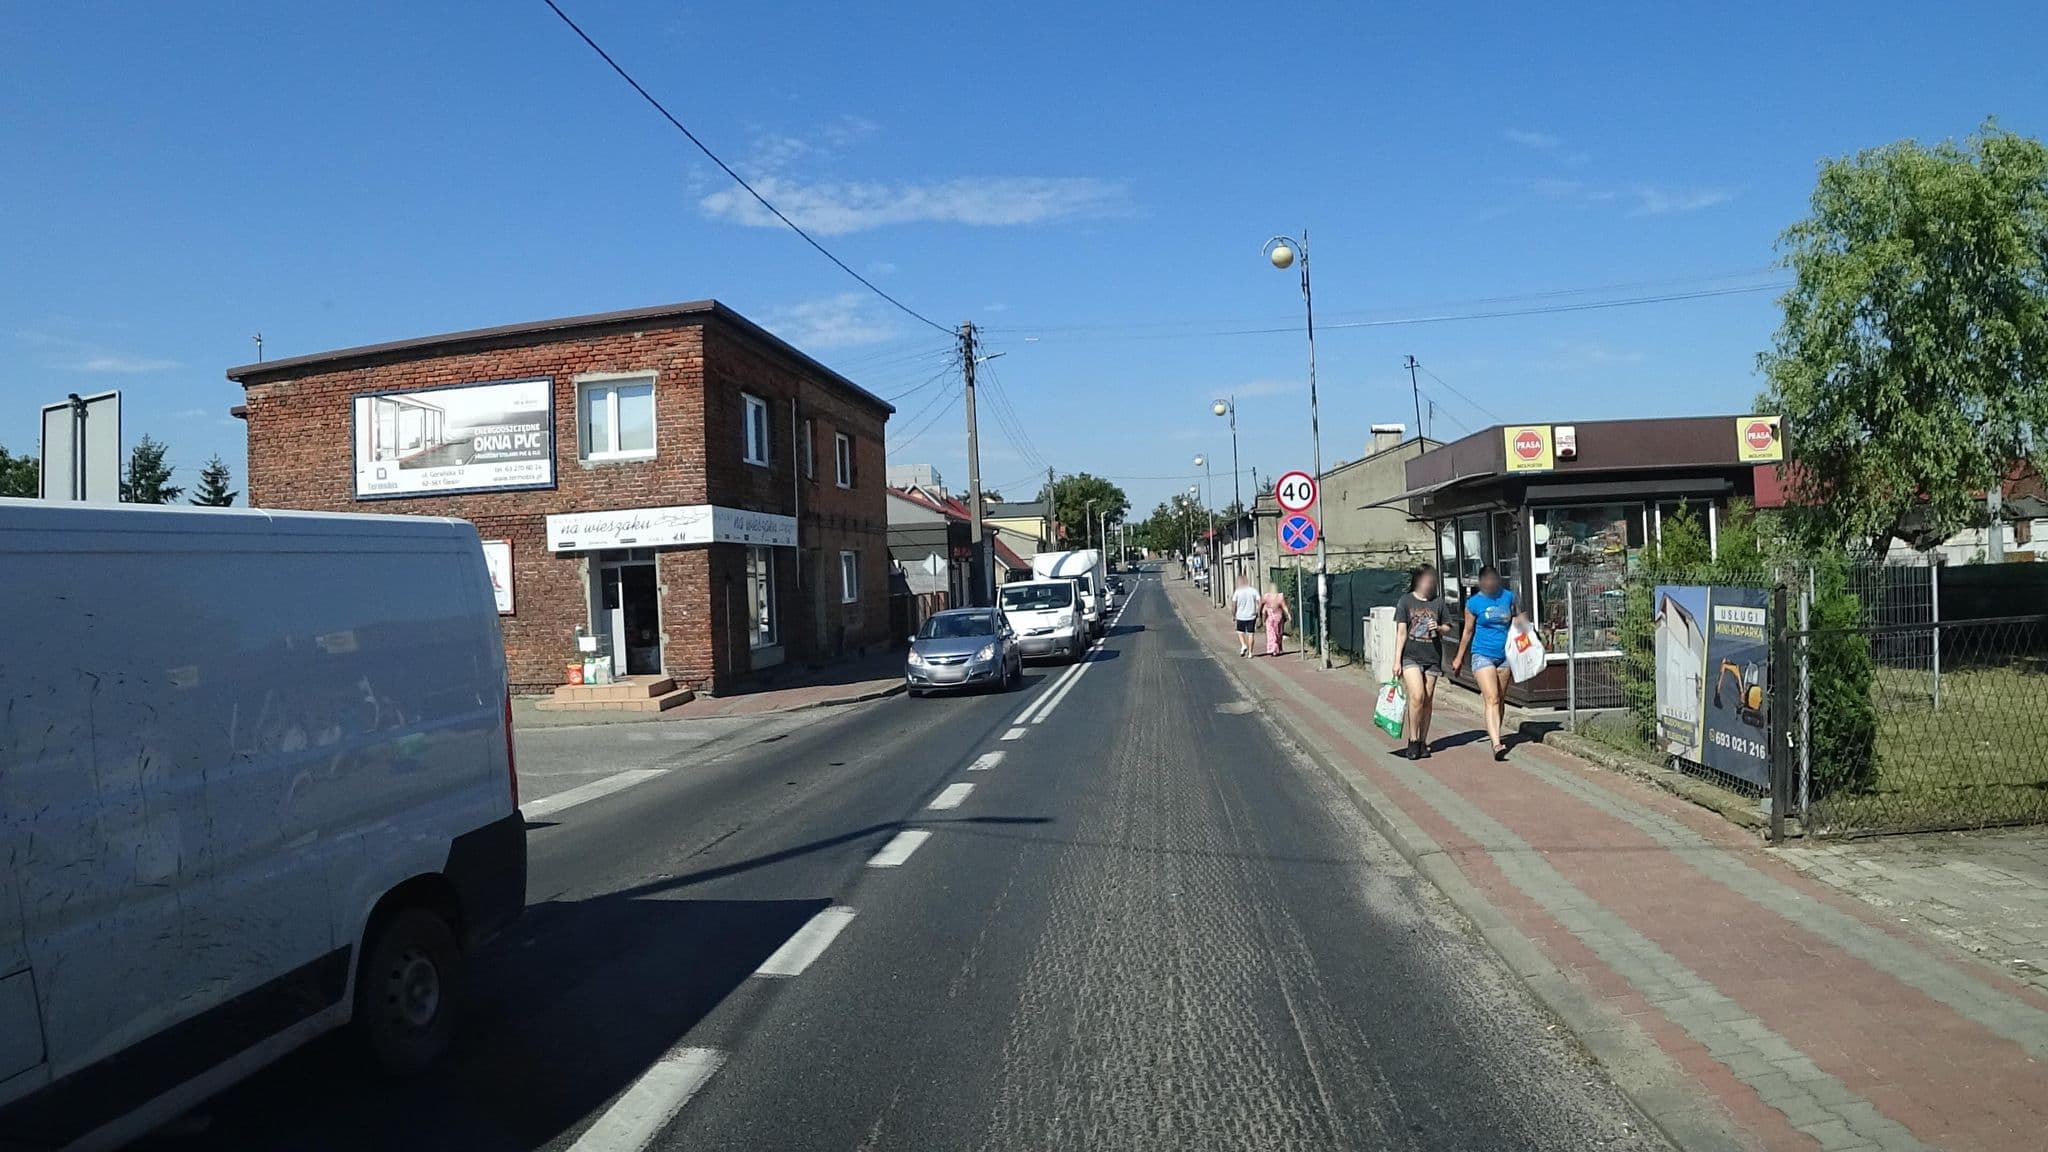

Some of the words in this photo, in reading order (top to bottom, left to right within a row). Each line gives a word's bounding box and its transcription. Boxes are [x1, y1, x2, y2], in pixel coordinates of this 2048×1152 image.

[474, 435, 512, 451] OKNA
[514, 432, 541, 449] PVC
[1517, 440, 1541, 449] PRASA
[1748, 431, 1770, 440] PRASA
[1283, 482, 1311, 501] 40
[560, 522, 578, 535] na
[583, 513, 651, 538] wieszaku
[1720, 609, 1759, 622] USŁUGI
[1715, 623, 1764, 643] MINI-KOPARKĄ
[1715, 730, 1731, 748] 693
[1732, 734, 1747, 754] 021
[1749, 740, 1766, 760] 216
